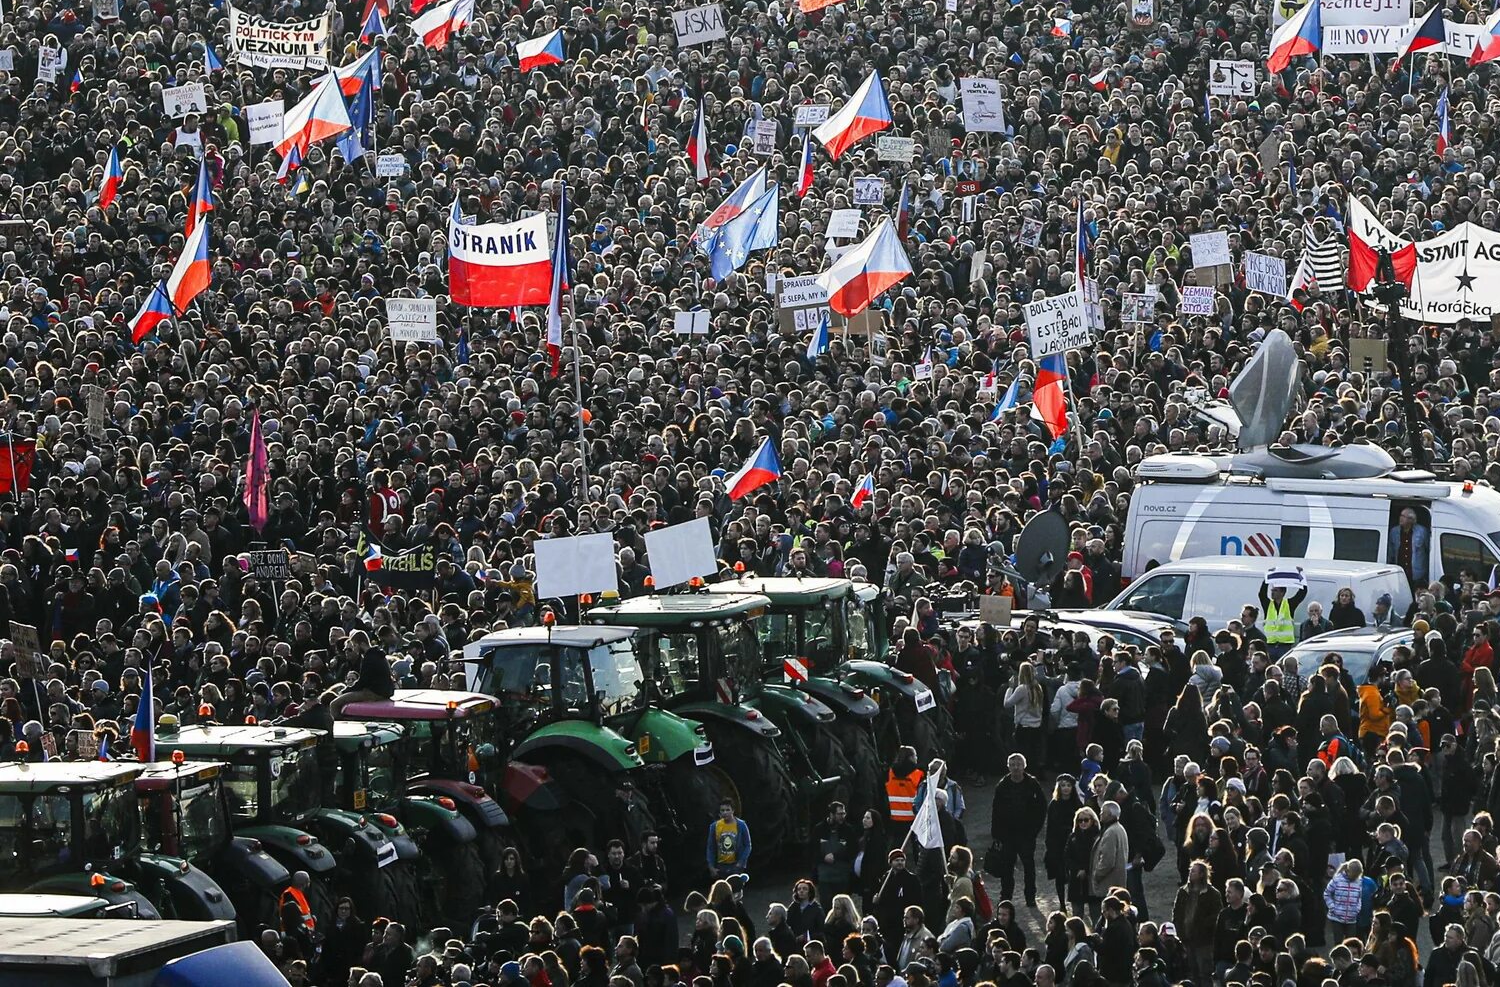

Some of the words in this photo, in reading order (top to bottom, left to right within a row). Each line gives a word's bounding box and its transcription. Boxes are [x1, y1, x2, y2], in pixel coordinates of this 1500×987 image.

[676, 5, 725, 37] LÁSKA
[961, 185, 976, 193] StB
[453, 228, 538, 255] STRANÍK
[808, 291, 819, 300] MY
[1183, 287, 1214, 296] ZEMANE
[1056, 310, 1064, 320] A
[1144, 504, 1177, 513] nova.cz
